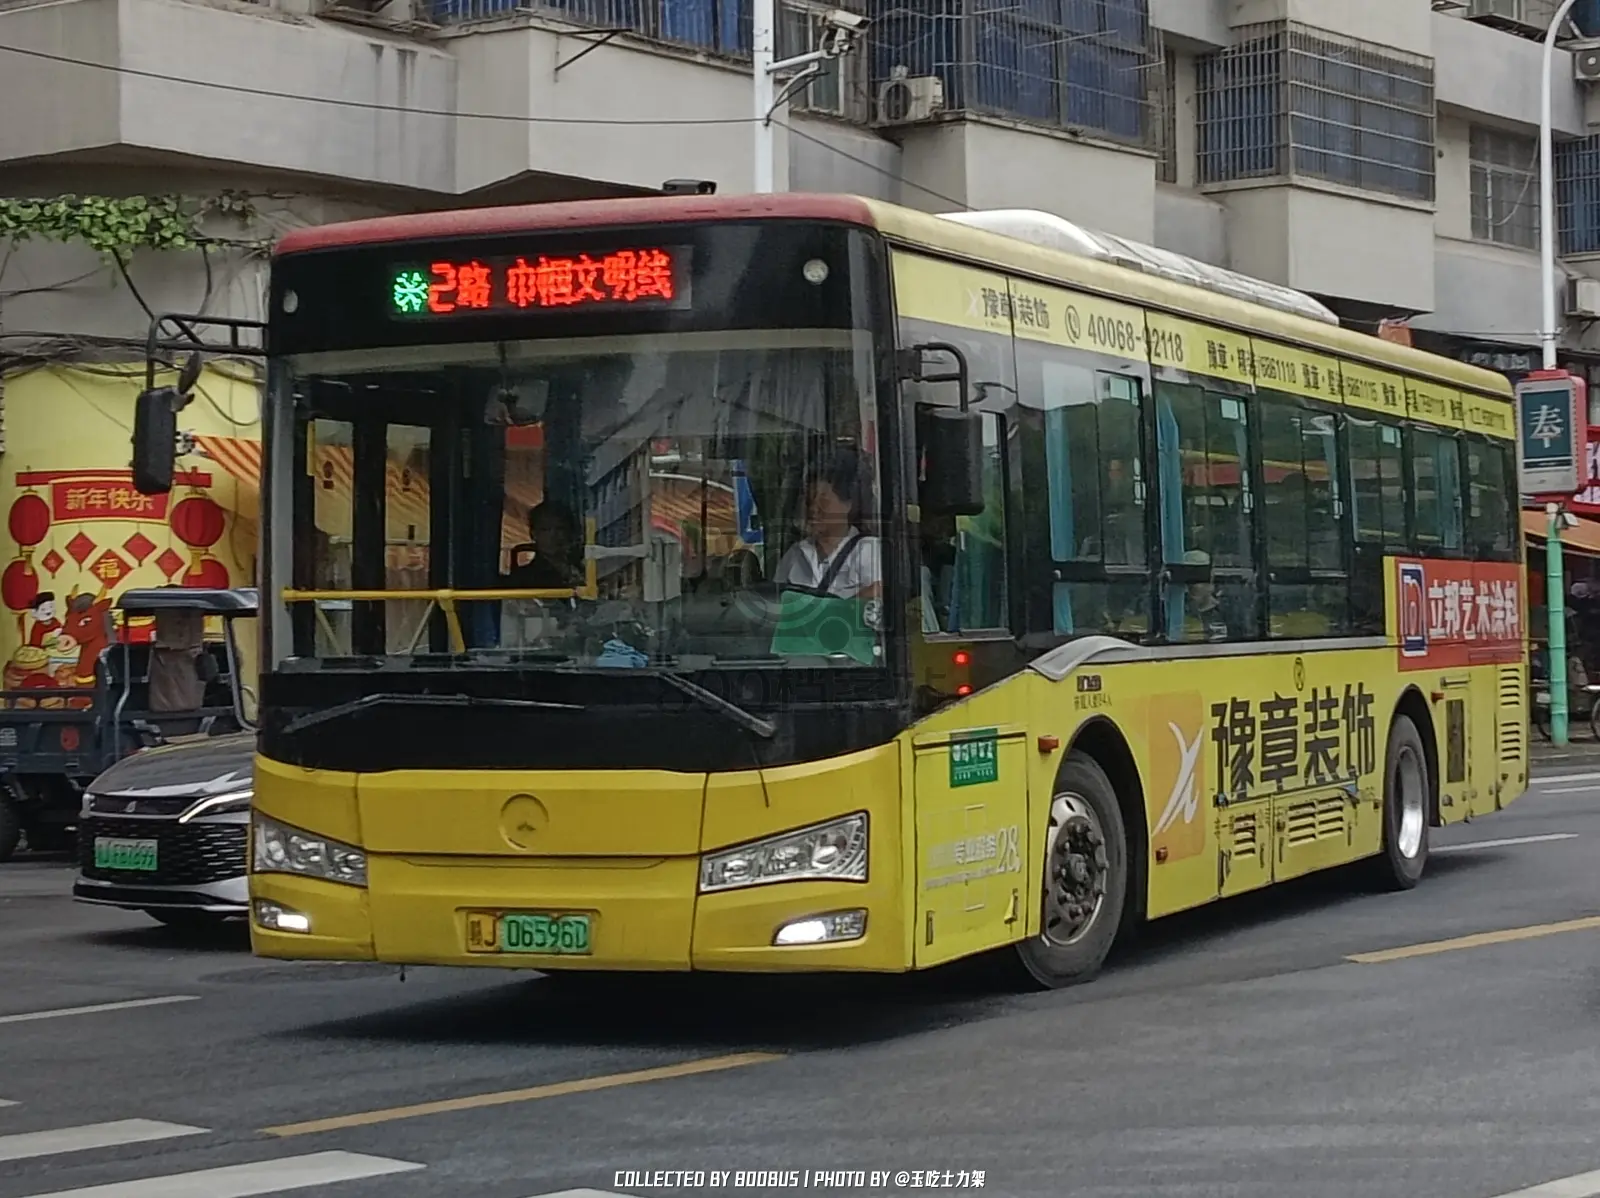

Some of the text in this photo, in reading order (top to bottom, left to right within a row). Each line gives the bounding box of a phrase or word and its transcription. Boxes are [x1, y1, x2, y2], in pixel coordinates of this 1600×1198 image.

[507, 248, 673, 308] 巾帼文明线
[1528, 404, 1564, 449] 奉
[64, 488, 154, 512] 新年快乐
[97, 558, 121, 579] 福
[1428, 579, 1520, 641] 立邦艺术涂料
[1211, 682, 1376, 803] 豫章装饰
